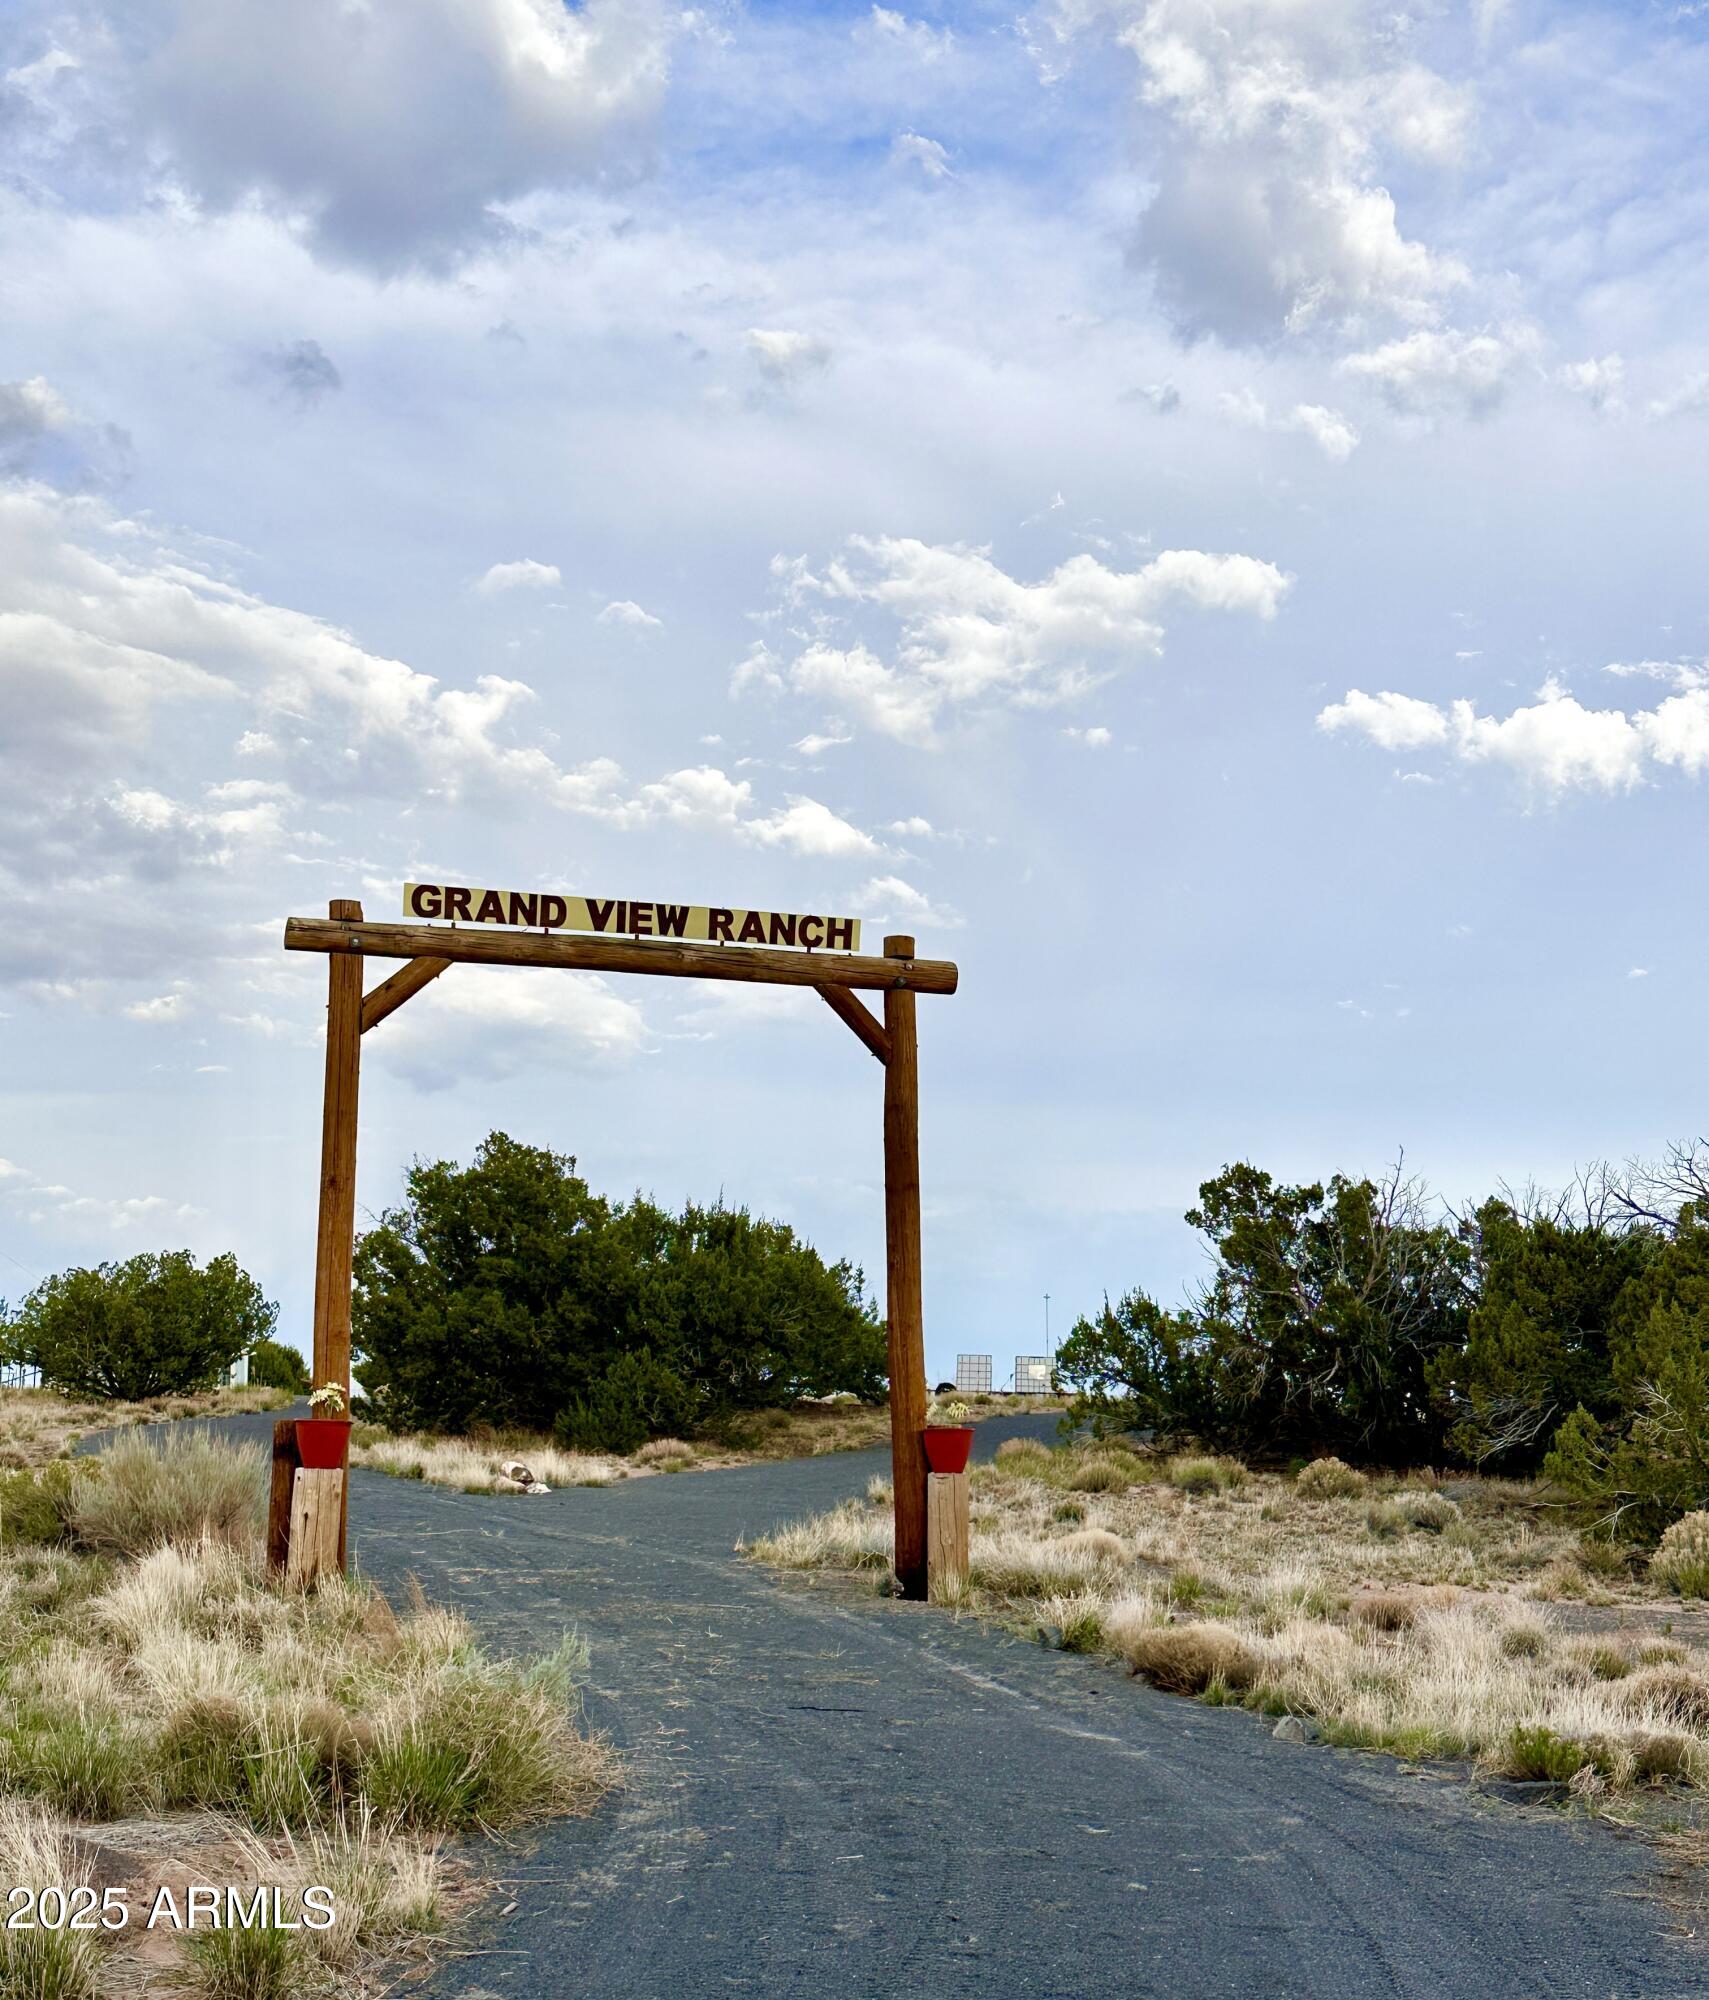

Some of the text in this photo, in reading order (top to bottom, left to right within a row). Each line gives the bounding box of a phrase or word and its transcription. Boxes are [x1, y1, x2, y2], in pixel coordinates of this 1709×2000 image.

[411, 884, 853, 950] GRAND VIEW RANCH
